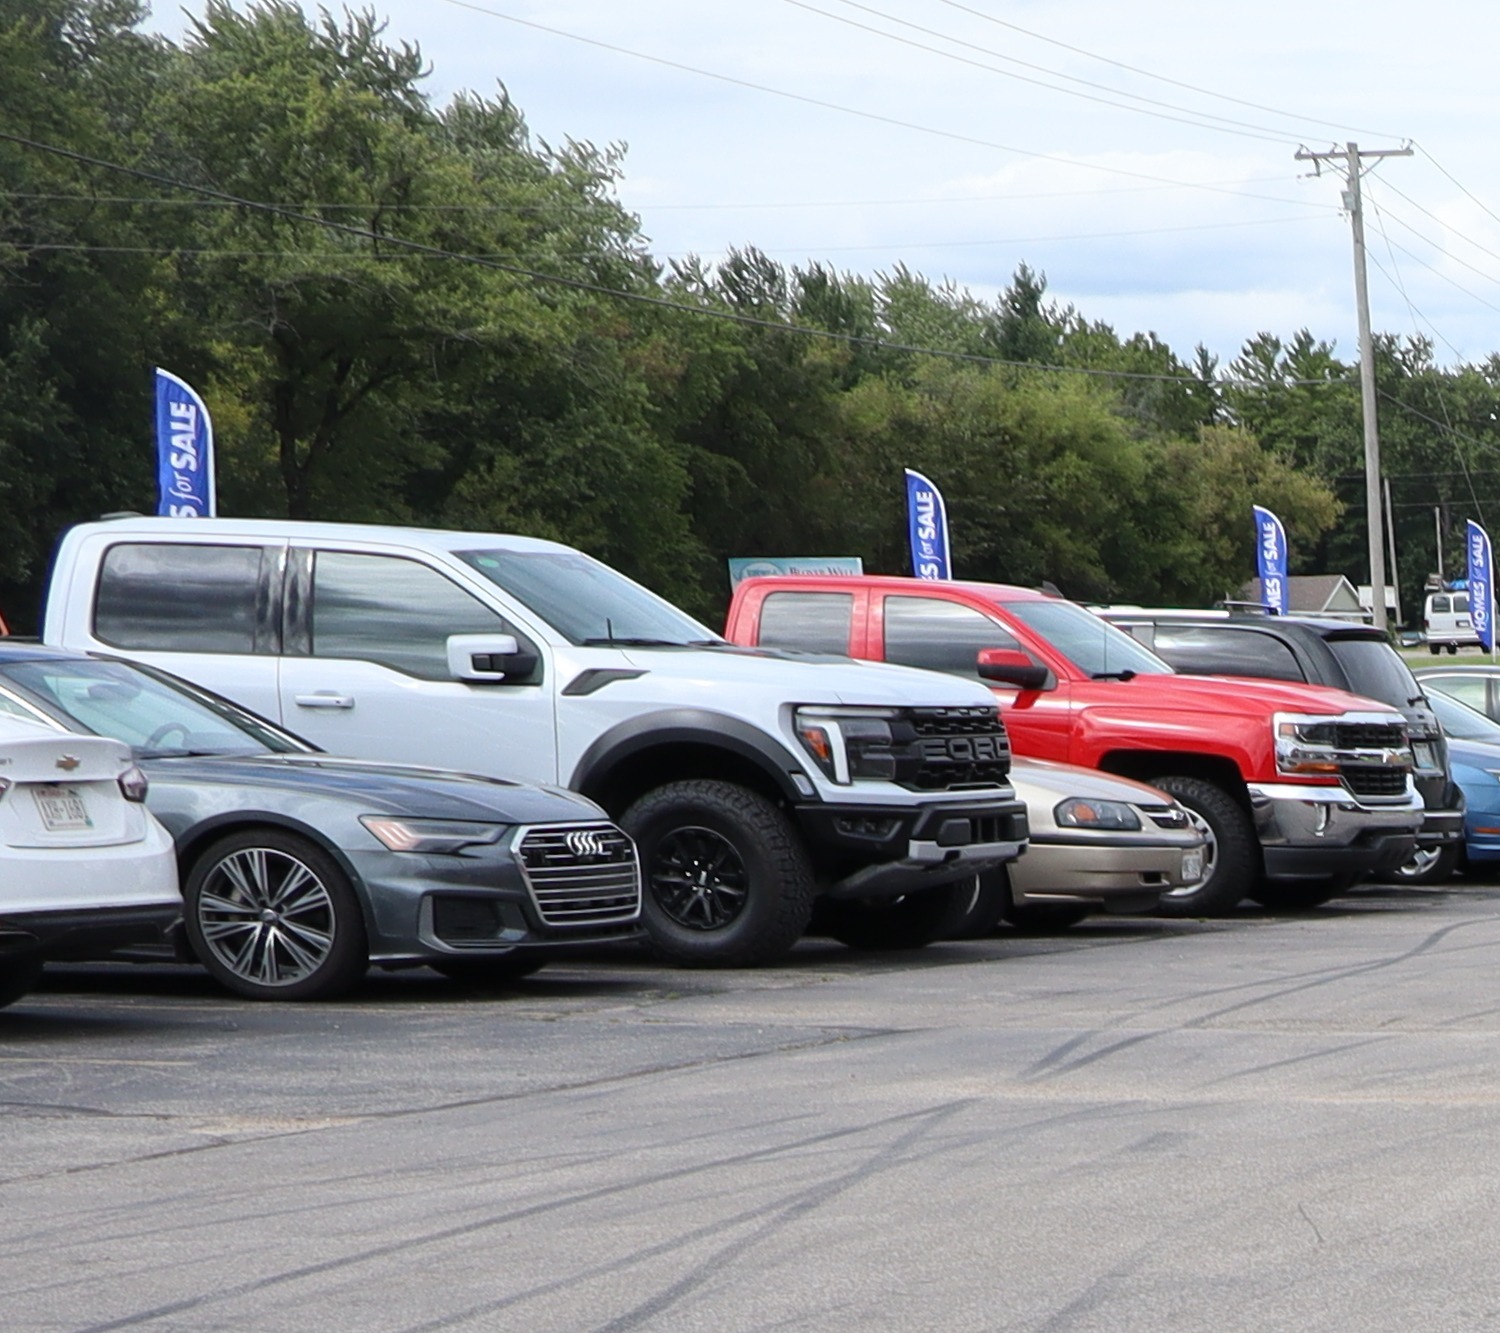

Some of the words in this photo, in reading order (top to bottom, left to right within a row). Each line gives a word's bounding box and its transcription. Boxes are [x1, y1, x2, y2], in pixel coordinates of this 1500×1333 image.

[169, 401, 198, 473] SALE
[916, 491, 936, 541] SALE
[1262, 521, 1278, 561] SALE
[1472, 534, 1484, 568] SALE
[1473, 581, 1487, 632] HOMES
